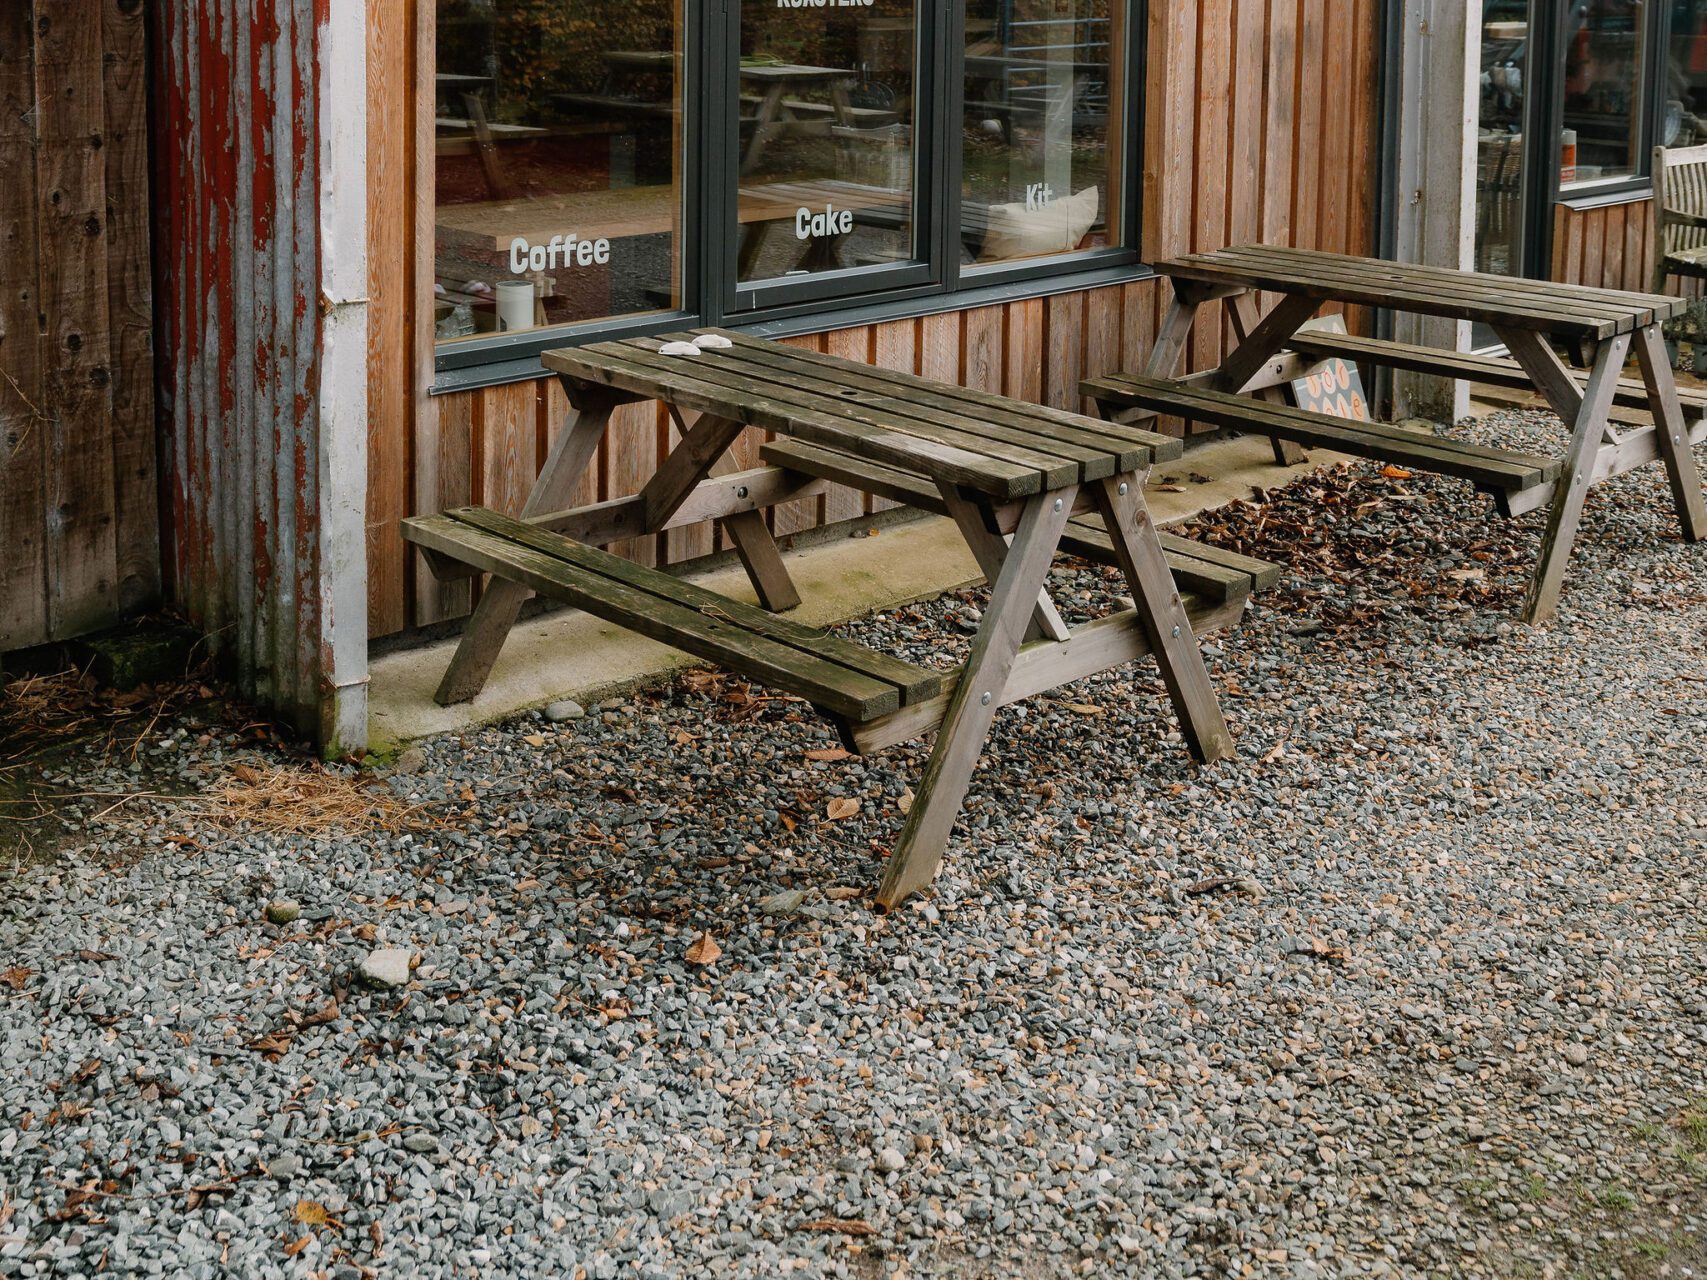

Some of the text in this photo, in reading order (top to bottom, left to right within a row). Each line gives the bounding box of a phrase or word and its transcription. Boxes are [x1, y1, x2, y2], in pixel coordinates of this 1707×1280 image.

[1026, 183, 1053, 215] Kit
[796, 204, 853, 239] Cake
[510, 234, 609, 274] Coffee
